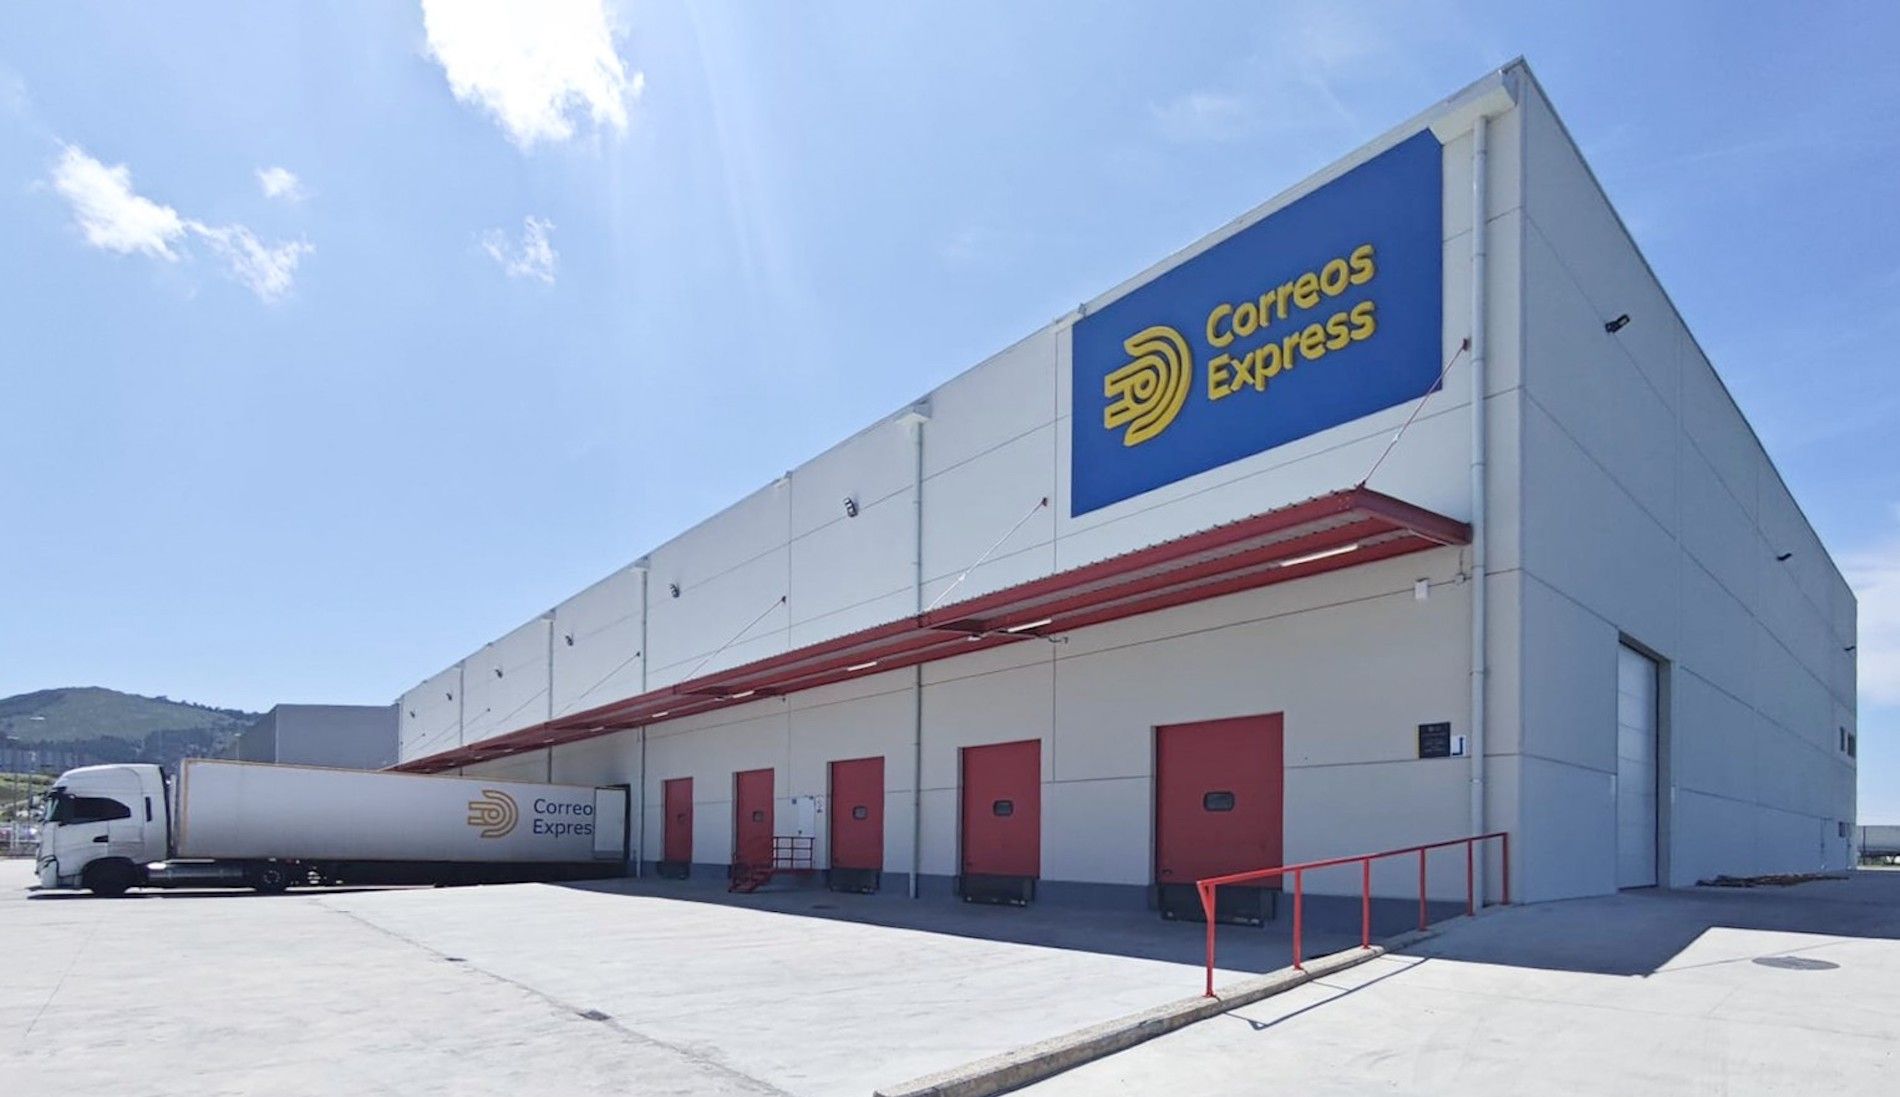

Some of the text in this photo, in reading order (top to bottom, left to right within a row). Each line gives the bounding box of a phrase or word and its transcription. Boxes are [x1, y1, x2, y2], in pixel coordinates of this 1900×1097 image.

[1207, 244, 1375, 347] Correos
[1208, 301, 1375, 400] Express
[533, 818, 593, 838] Expres
[534, 798, 593, 816] Correo
